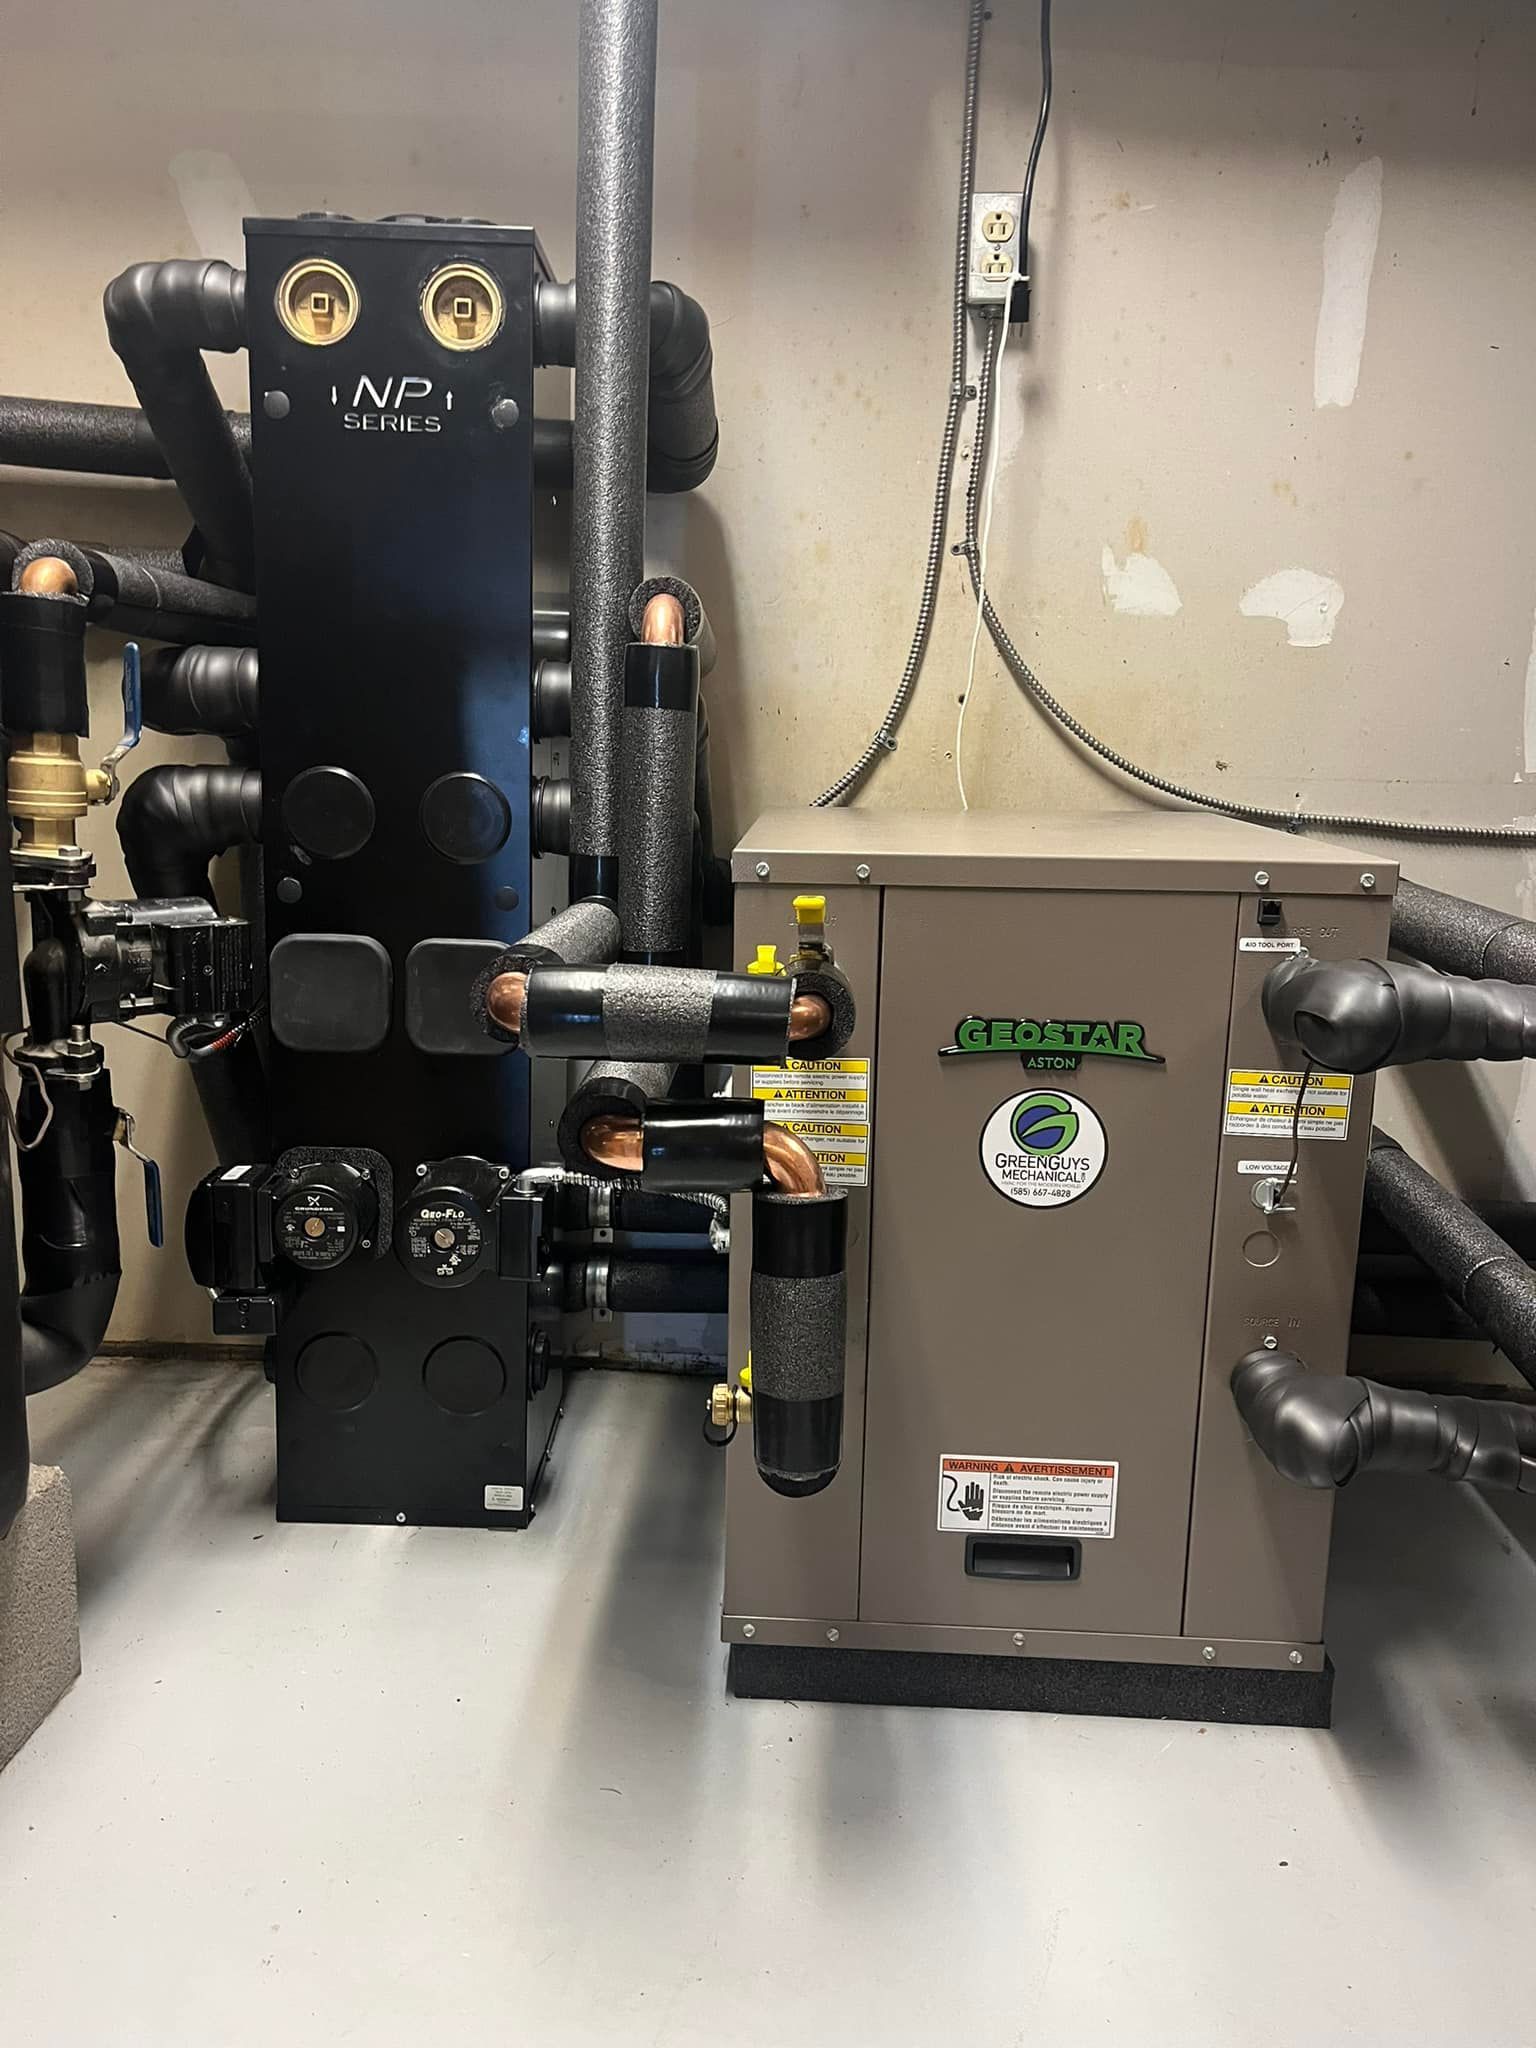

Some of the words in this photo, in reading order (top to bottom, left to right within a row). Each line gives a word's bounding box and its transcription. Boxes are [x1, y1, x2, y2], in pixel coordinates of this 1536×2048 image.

[352, 375, 432, 409] NP
[344, 412, 441, 432] SERIES
[958, 1019, 1147, 1056] GEOSTAR
[791, 1061, 842, 1070] CAUTION
[1027, 1056, 1076, 1069] ASTON
[1272, 1074, 1324, 1087] CAUTON
[785, 1089, 847, 1100] ATTENTION
[792, 1123, 842, 1134] CAUTION
[813, 1152, 846, 1163] NTION
[995, 1152, 1091, 1171] GREENGUYS
[1002, 1169, 1081, 1183] MECHANICAL
[1010, 1187, 1031, 1197] (585)
[1033, 1188, 1072, 1198] 667-4828
[949, 1461, 999, 1471] WARNING
[1020, 1463, 1109, 1477] AVERTISSEMENT
